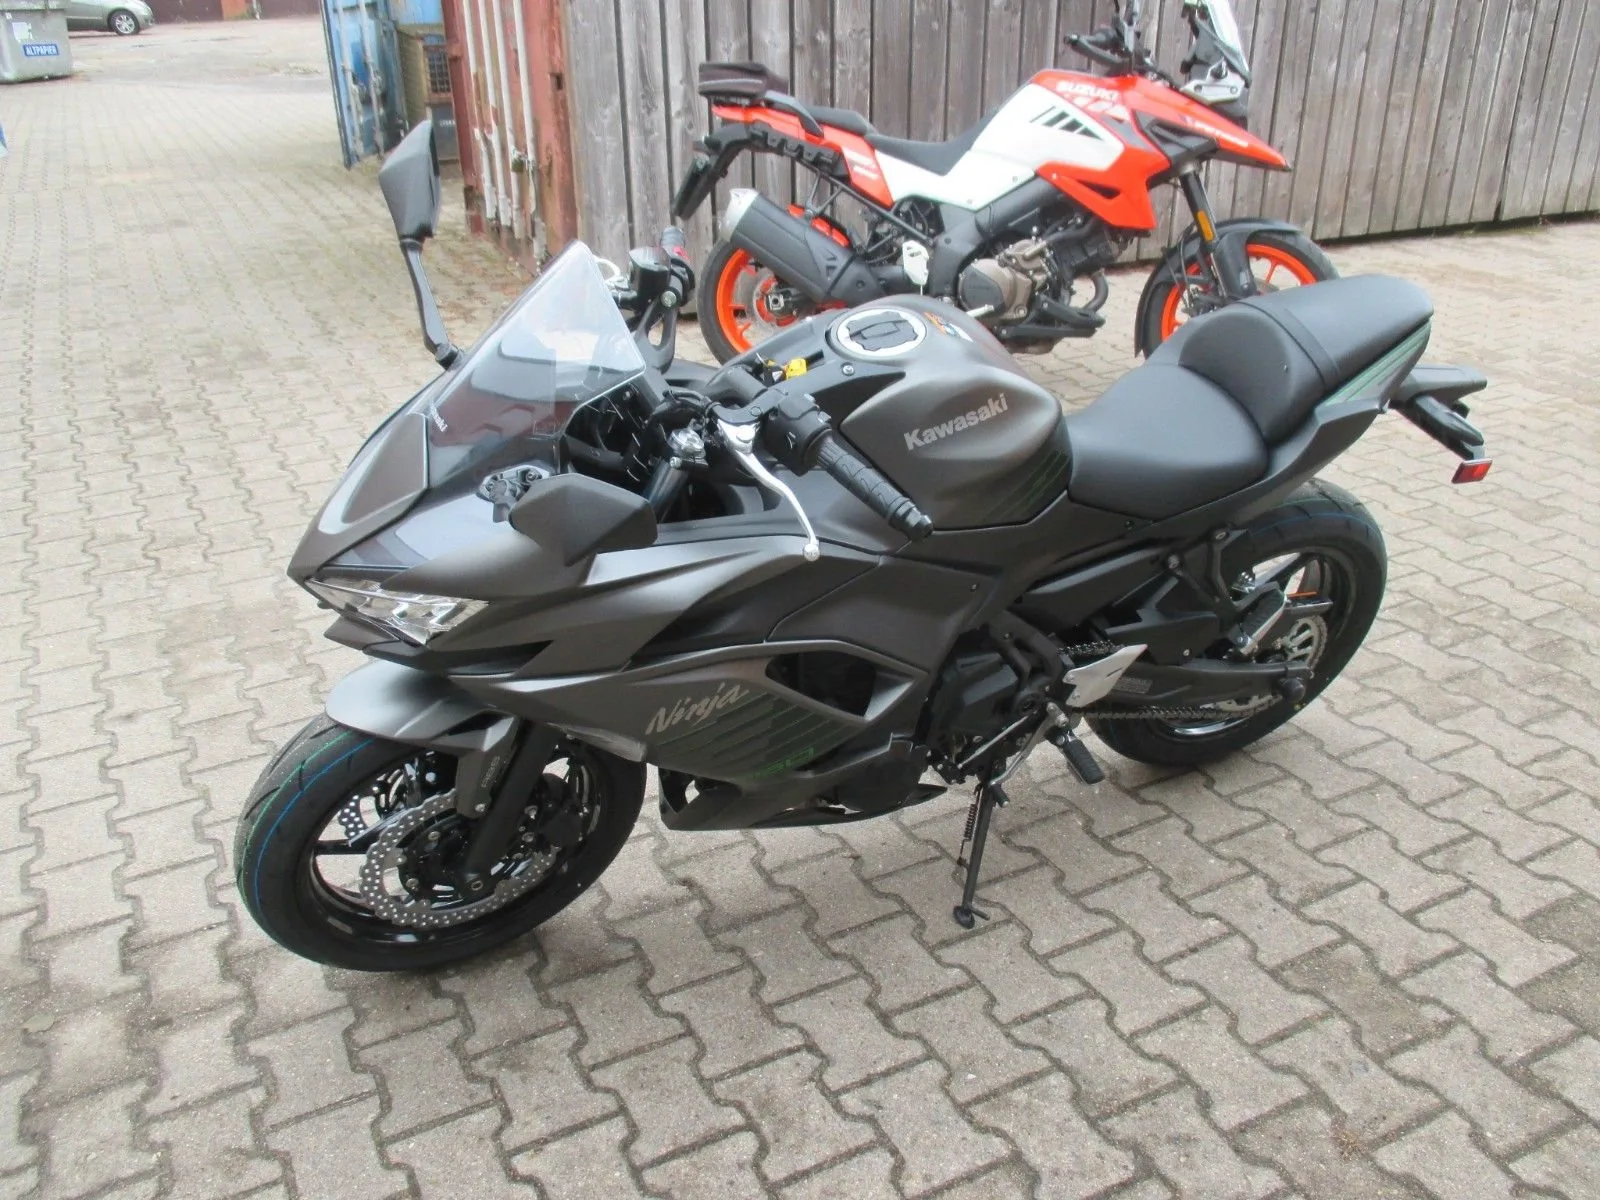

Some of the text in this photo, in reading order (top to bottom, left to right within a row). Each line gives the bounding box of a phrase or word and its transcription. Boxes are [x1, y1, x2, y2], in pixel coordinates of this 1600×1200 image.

[25, 44, 58, 56] ALTPAPIER
[1056, 81, 1119, 102] SUZUKI
[903, 392, 1009, 451] Kawasaki
[645, 681, 750, 735] Ninja
